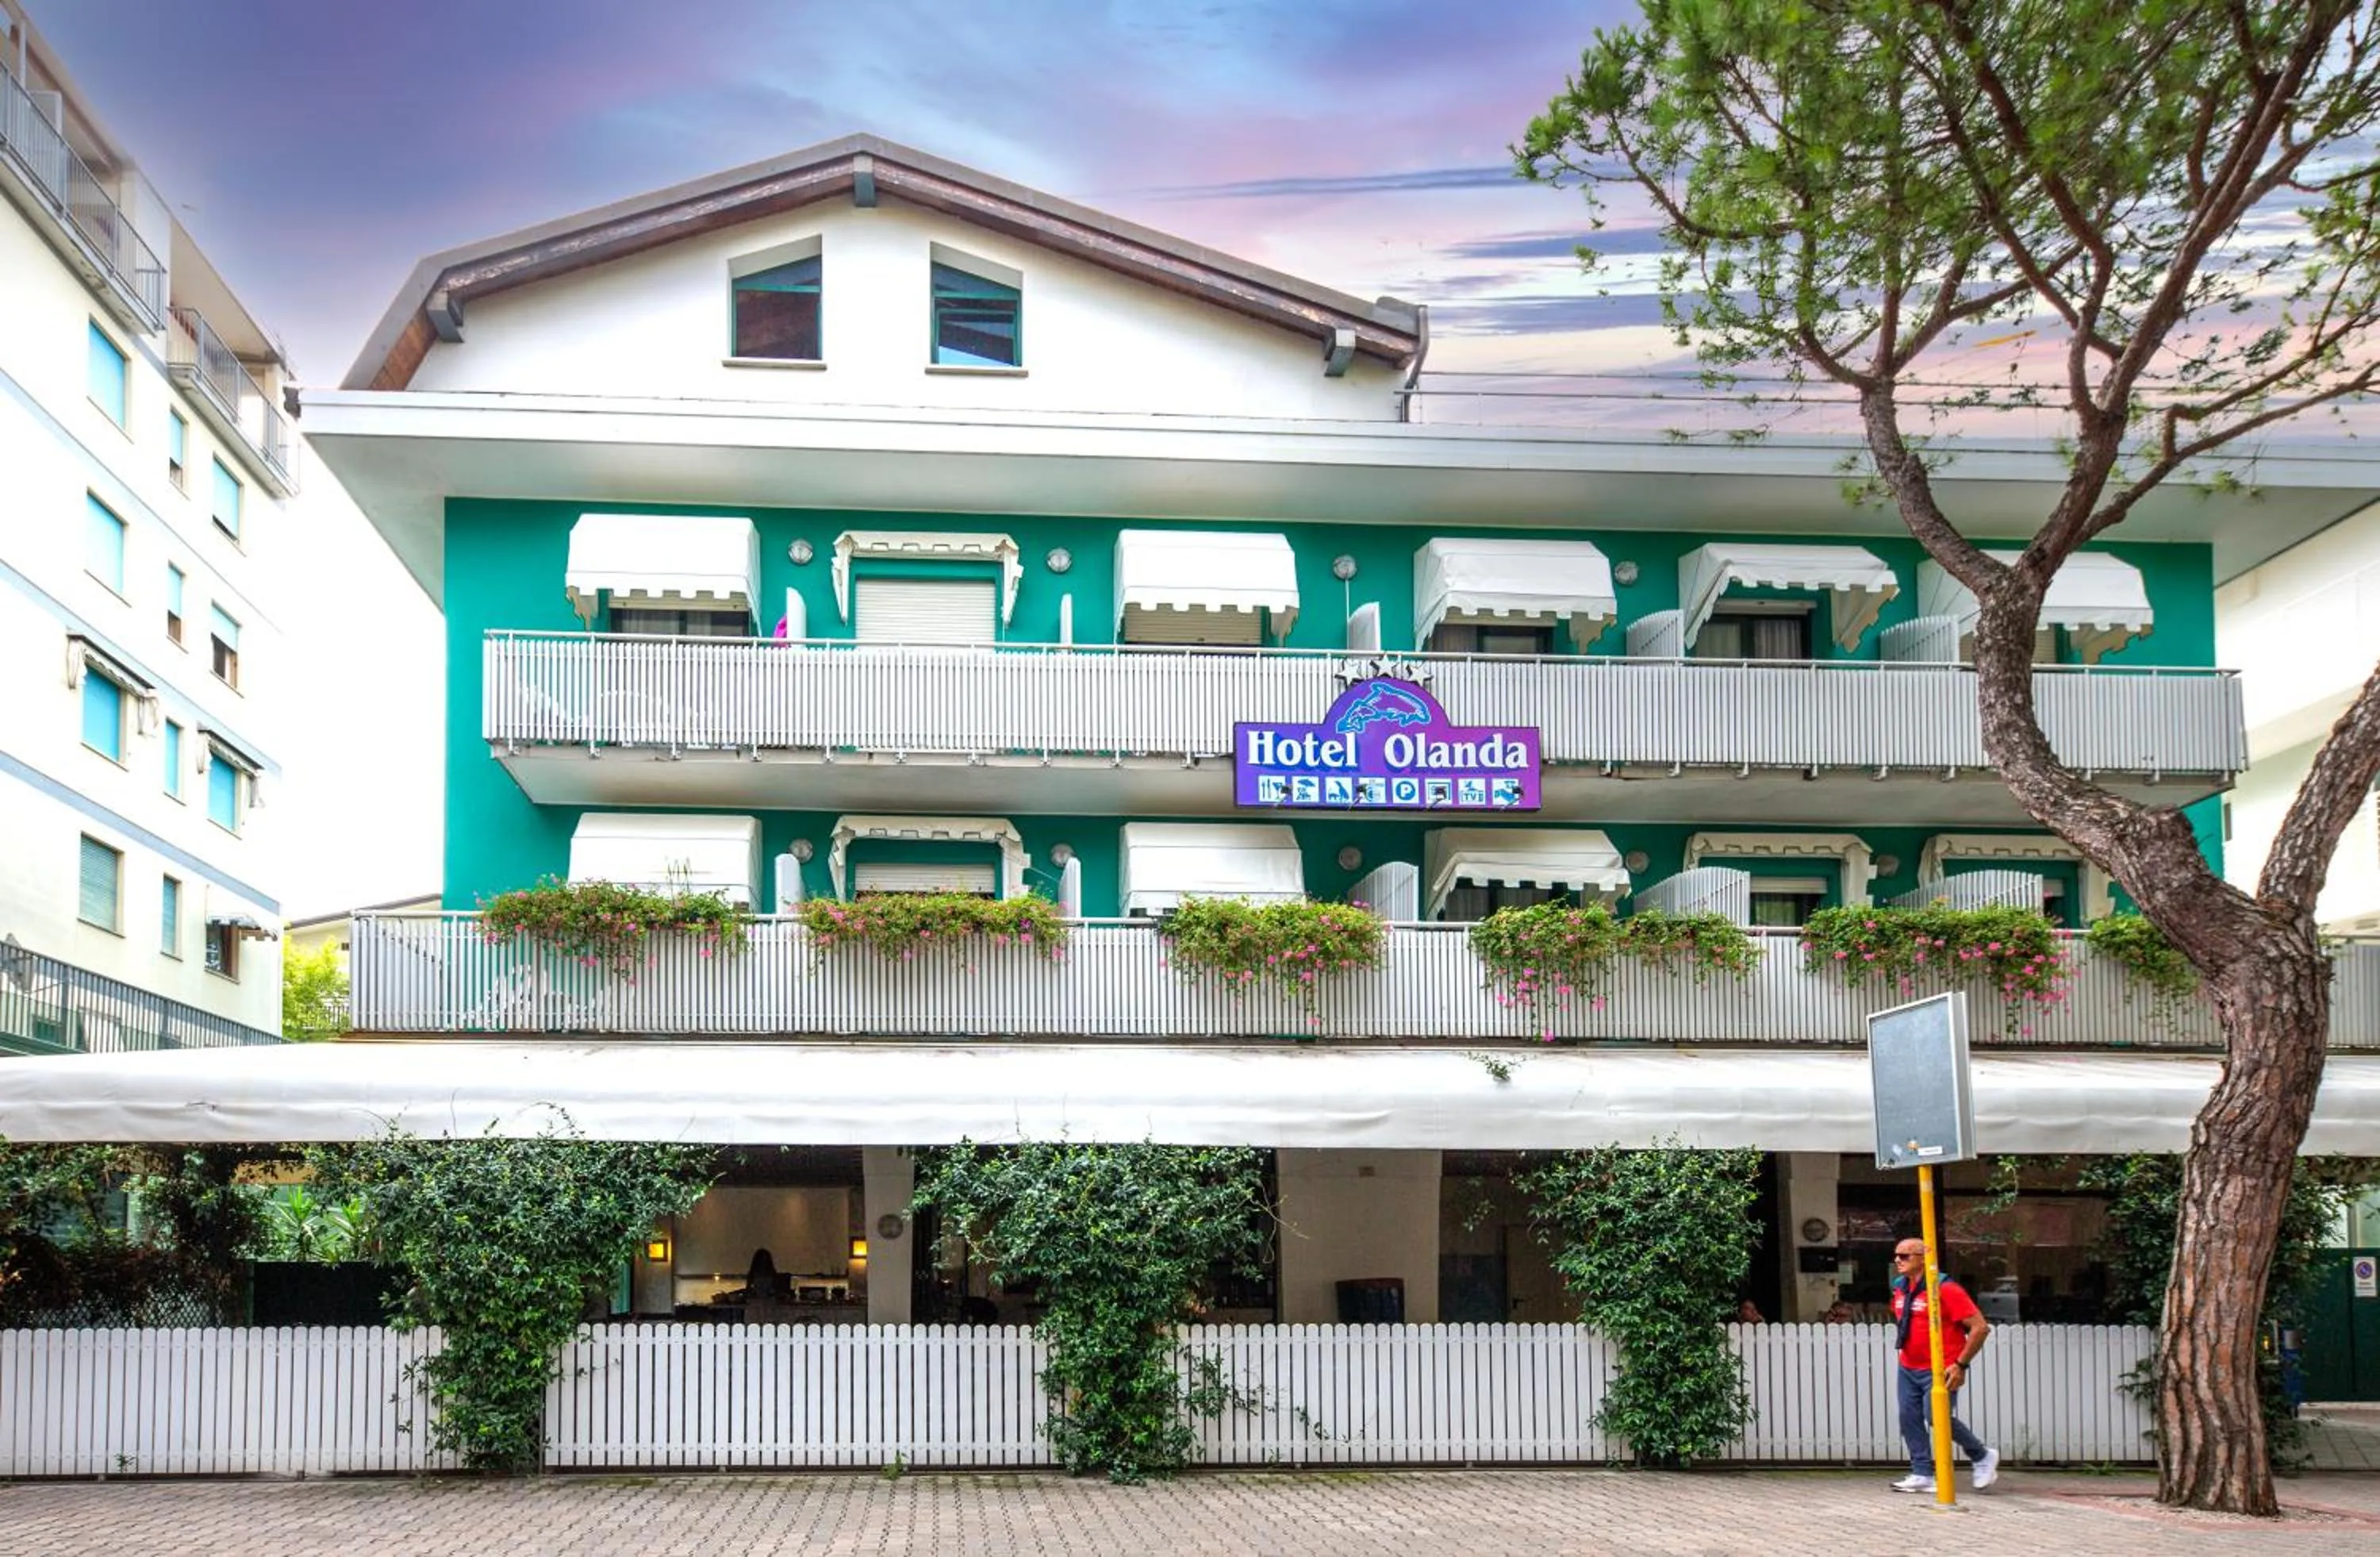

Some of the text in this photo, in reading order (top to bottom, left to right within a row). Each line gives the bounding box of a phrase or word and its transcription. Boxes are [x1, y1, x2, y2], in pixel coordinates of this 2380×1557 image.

[1247, 730, 1528, 769] Hotel Olanda
[1400, 783, 1412, 797] P
